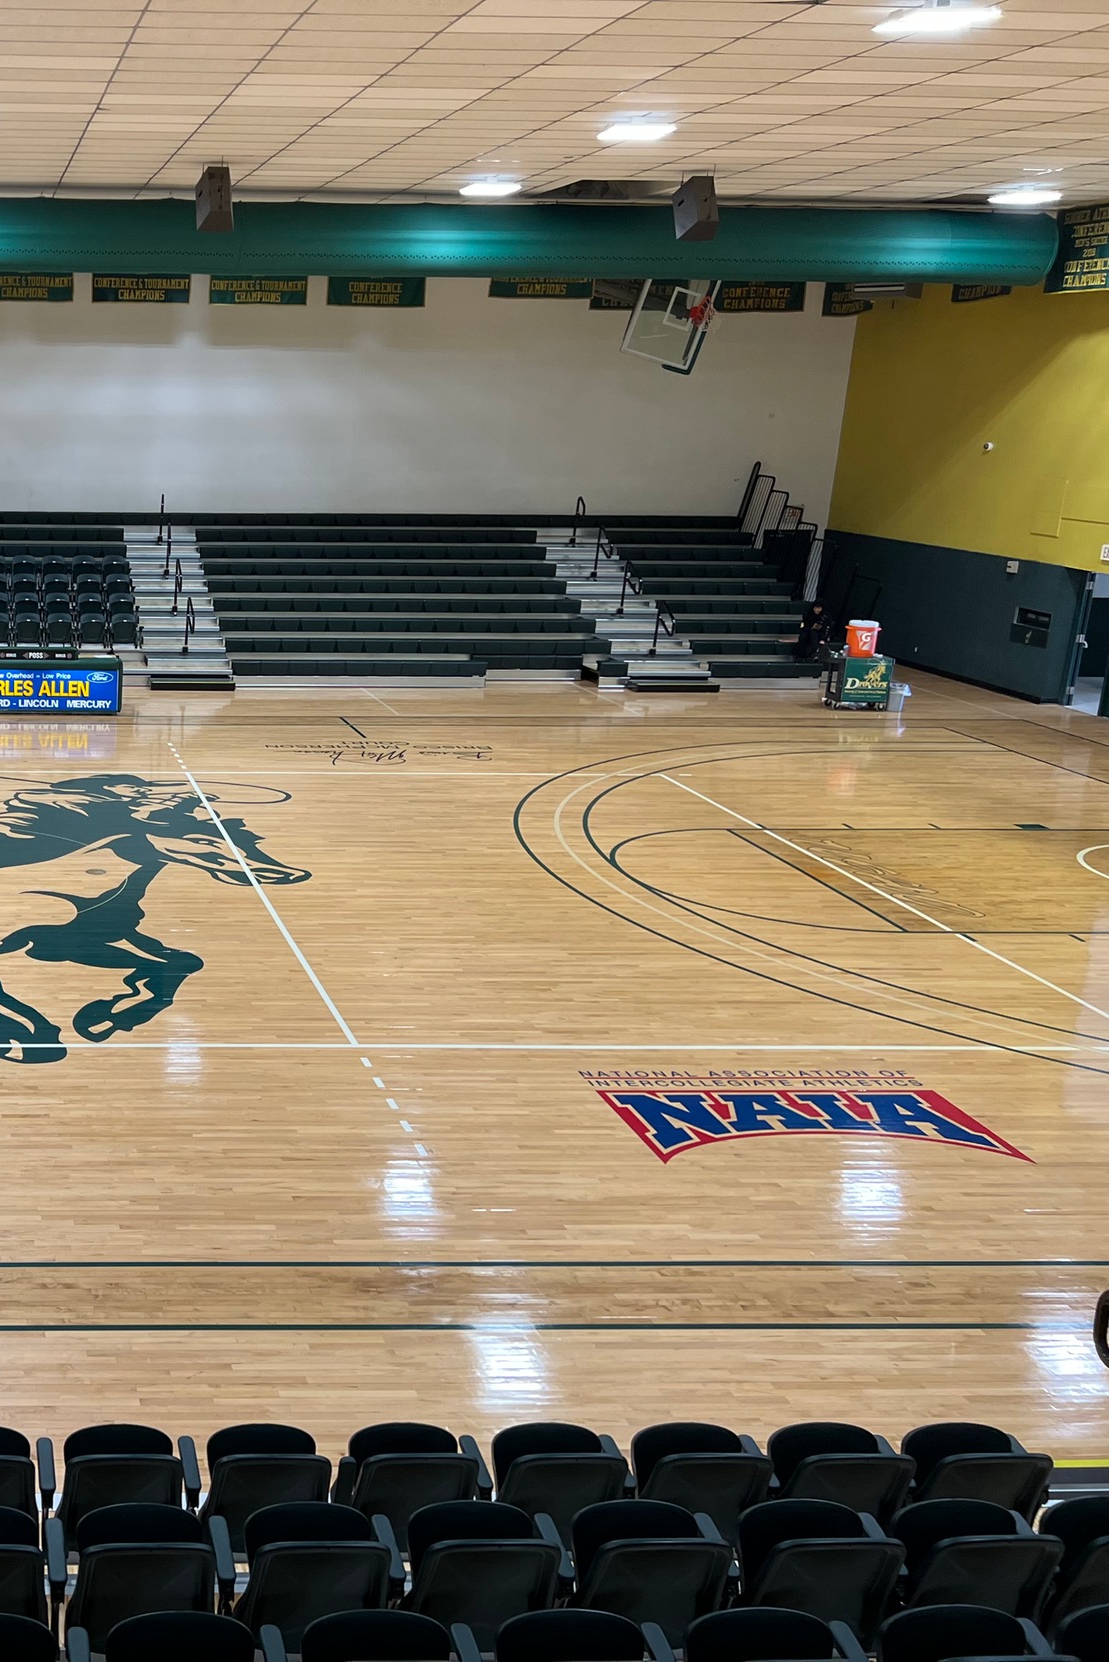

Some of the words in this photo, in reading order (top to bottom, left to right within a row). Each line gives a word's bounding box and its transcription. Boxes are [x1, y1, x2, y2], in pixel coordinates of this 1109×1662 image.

[27, 276, 72, 287] TOURNAMENT
[94, 277, 137, 289] CONFERENCE
[144, 278, 189, 290] TOURNAMENT
[211, 279, 254, 291] CONFERENCE
[261, 280, 306, 291] TOURNAMENT
[1063, 273, 1107, 288] CHAMPIONS
[1, 287, 48, 298] CHAMPIONS
[348, 281, 403, 293] CONFERENCE
[517, 283, 568, 295] CHAMPIONS
[722, 287, 791, 298] CONFERENCE
[118, 289, 165, 301] CHAMPIONS
[235, 291, 281, 303] CHAMPIONS
[351, 293, 400, 305] CHAMPIONS
[723, 298, 786, 310] CHAMPIONS
[862, 632, 871, 642] G
[55, 672, 71, 680] Price
[38, 680, 90, 698] ALLEN
[845, 677, 888, 689] Drovers
[18, 699, 59, 708] LINCOLN
[66, 700, 112, 709] MERCURY
[578, 1070, 698, 1078] NATIONAL
[708, 1069, 870, 1078] ASSOCIATION
[587, 1080, 795, 1088] INTERCOLLEGIATE
[800, 1079, 924, 1088] ATHLETICS
[611, 1093, 1001, 1150] NAIA
